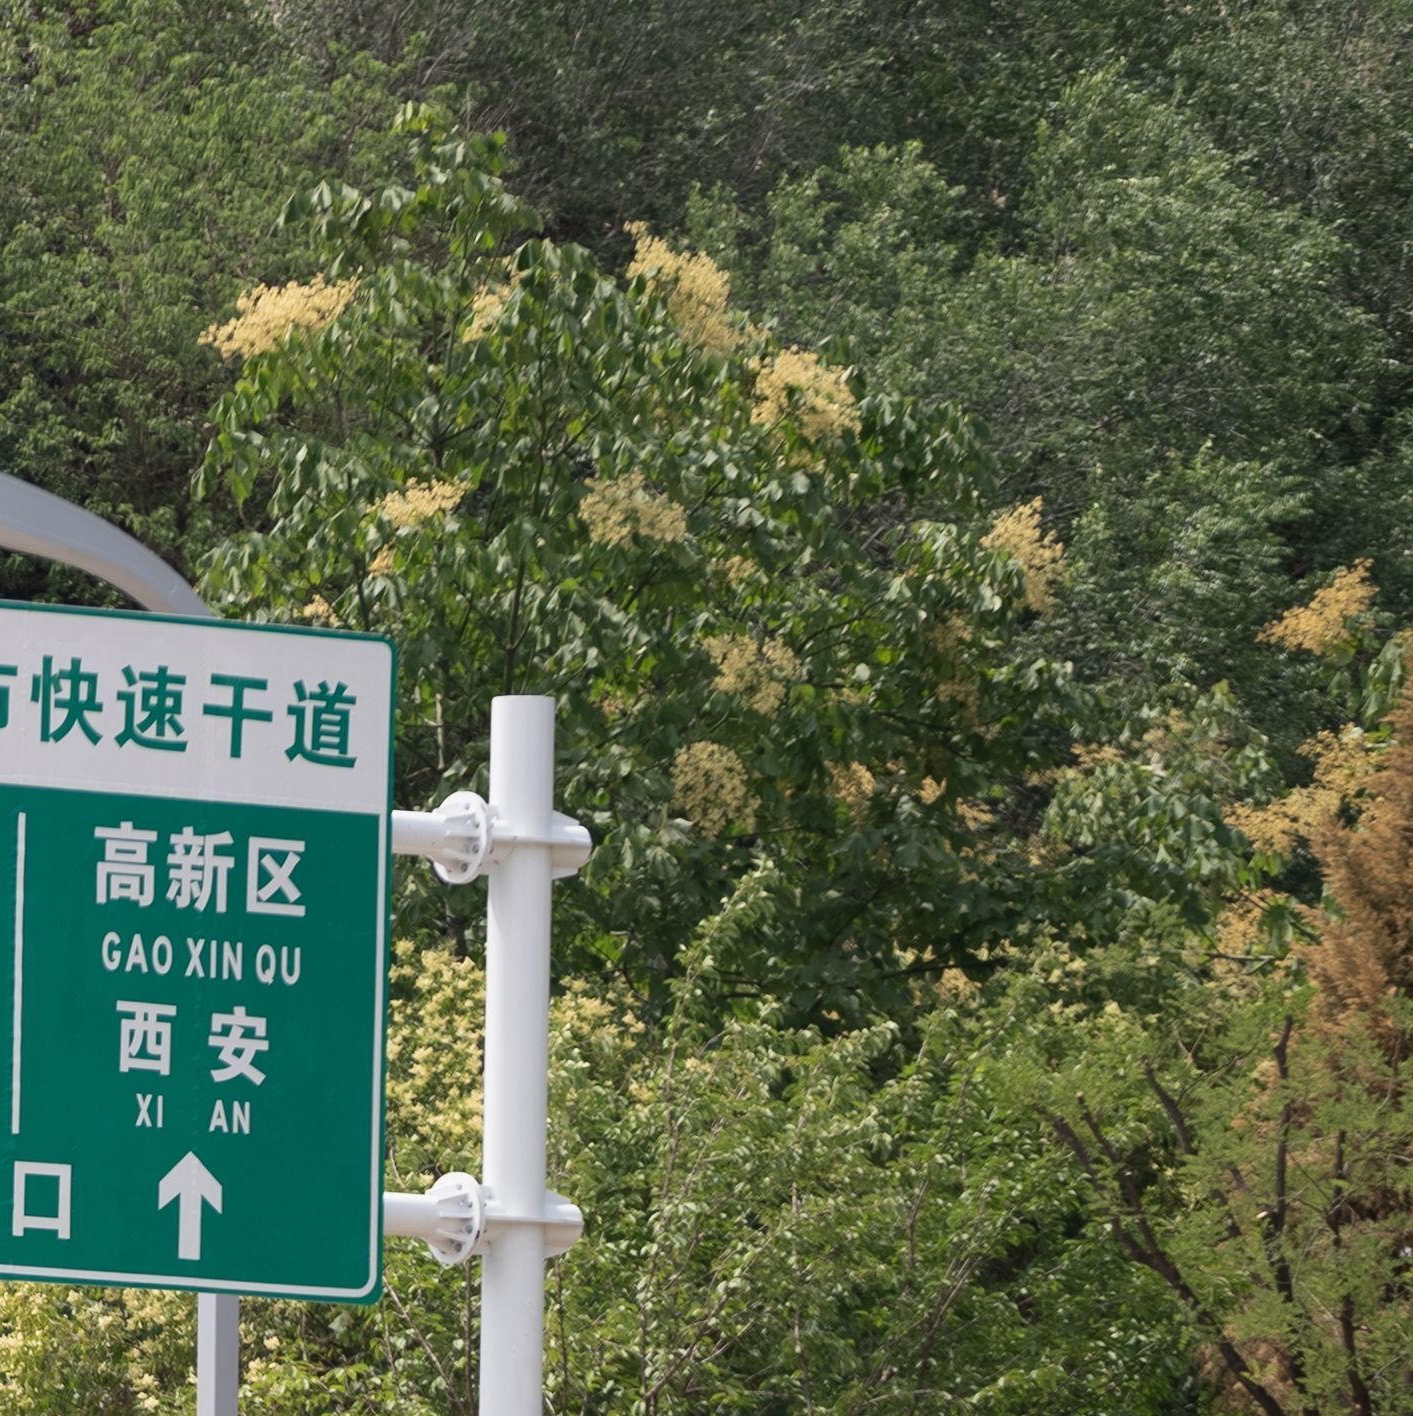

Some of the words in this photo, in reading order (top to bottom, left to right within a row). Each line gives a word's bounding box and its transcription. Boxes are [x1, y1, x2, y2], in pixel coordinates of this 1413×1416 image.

[95, 822, 305, 916] 高新区
[103, 932, 172, 974] GAO
[186, 939, 242, 980] XIN
[256, 945, 300, 984] QU
[117, 1001, 268, 1085] 西安
[136, 1094, 162, 1127] XI
[210, 1100, 249, 1133] AN
